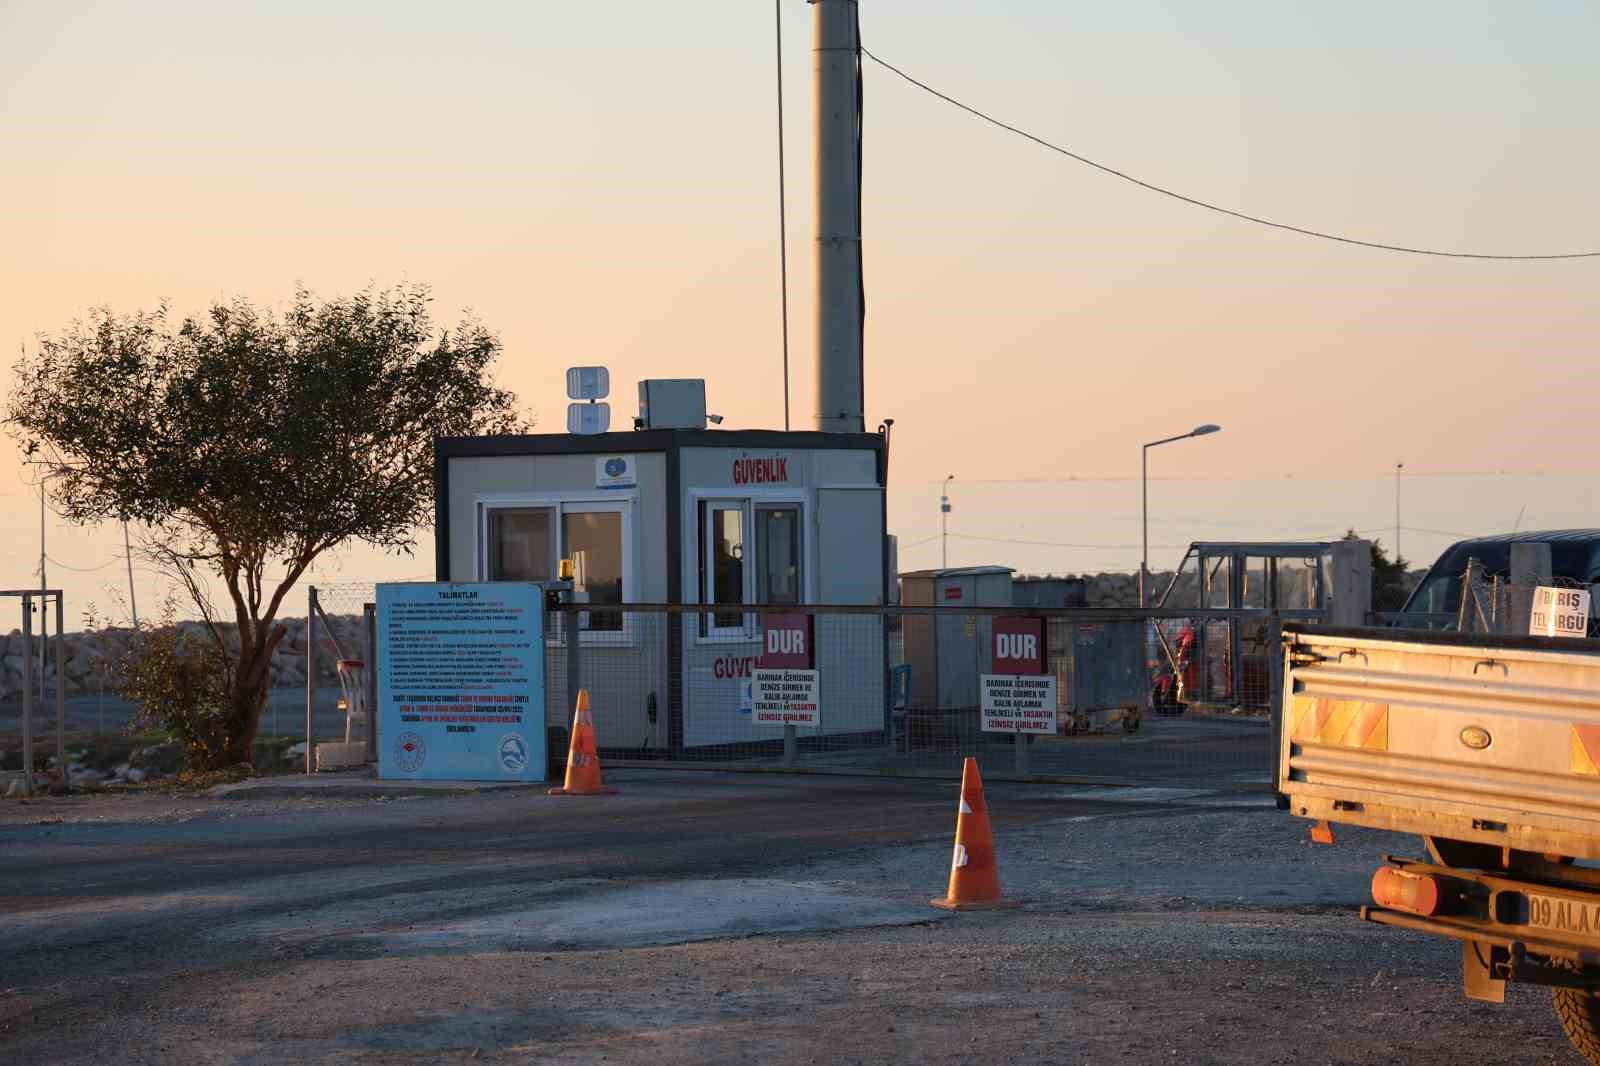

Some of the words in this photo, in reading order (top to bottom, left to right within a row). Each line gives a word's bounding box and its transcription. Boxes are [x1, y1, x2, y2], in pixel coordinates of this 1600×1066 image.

[733, 452, 787, 485] GÜVENLİK
[767, 629, 804, 654] DUR
[996, 632, 1037, 660] DUR
[1530, 897, 1551, 926] 09
